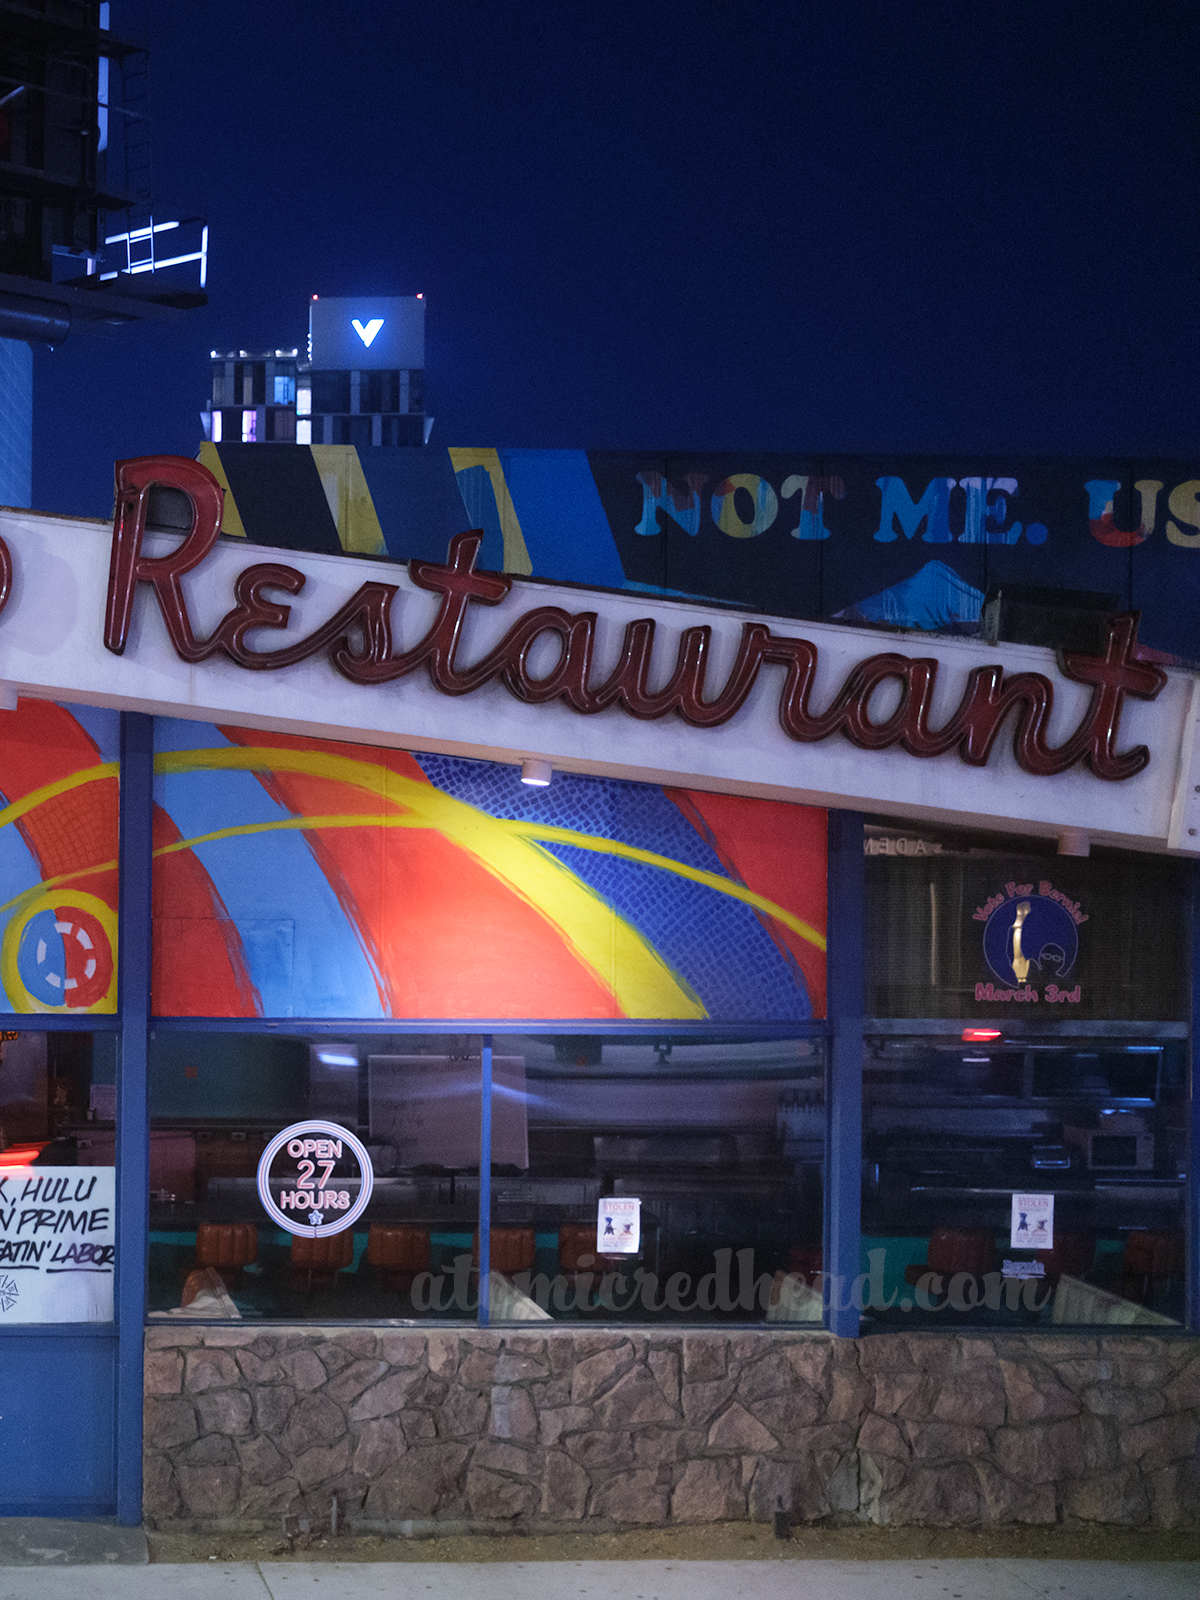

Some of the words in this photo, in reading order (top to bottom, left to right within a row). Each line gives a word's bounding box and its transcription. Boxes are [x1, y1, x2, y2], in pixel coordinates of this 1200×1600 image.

[634, 471, 846, 540] NOT
[872, 476, 1049, 545] ME.
[104, 454, 1167, 782] Restaurant
[972, 893, 1004, 921] Vote
[1004, 881, 1033, 898] For
[975, 983, 1039, 1002] March
[1045, 984, 1081, 1002] 3rd
[286, 1139, 343, 1159] OPEN
[296, 1159, 336, 1189] 27
[20, 1176, 98, 1203] HULU
[280, 1190, 351, 1210] HOURS
[1017, 1200, 1049, 1208] STOLEN
[16, 1208, 110, 1235] PRIME
[50, 1242, 115, 1266] LABOR
